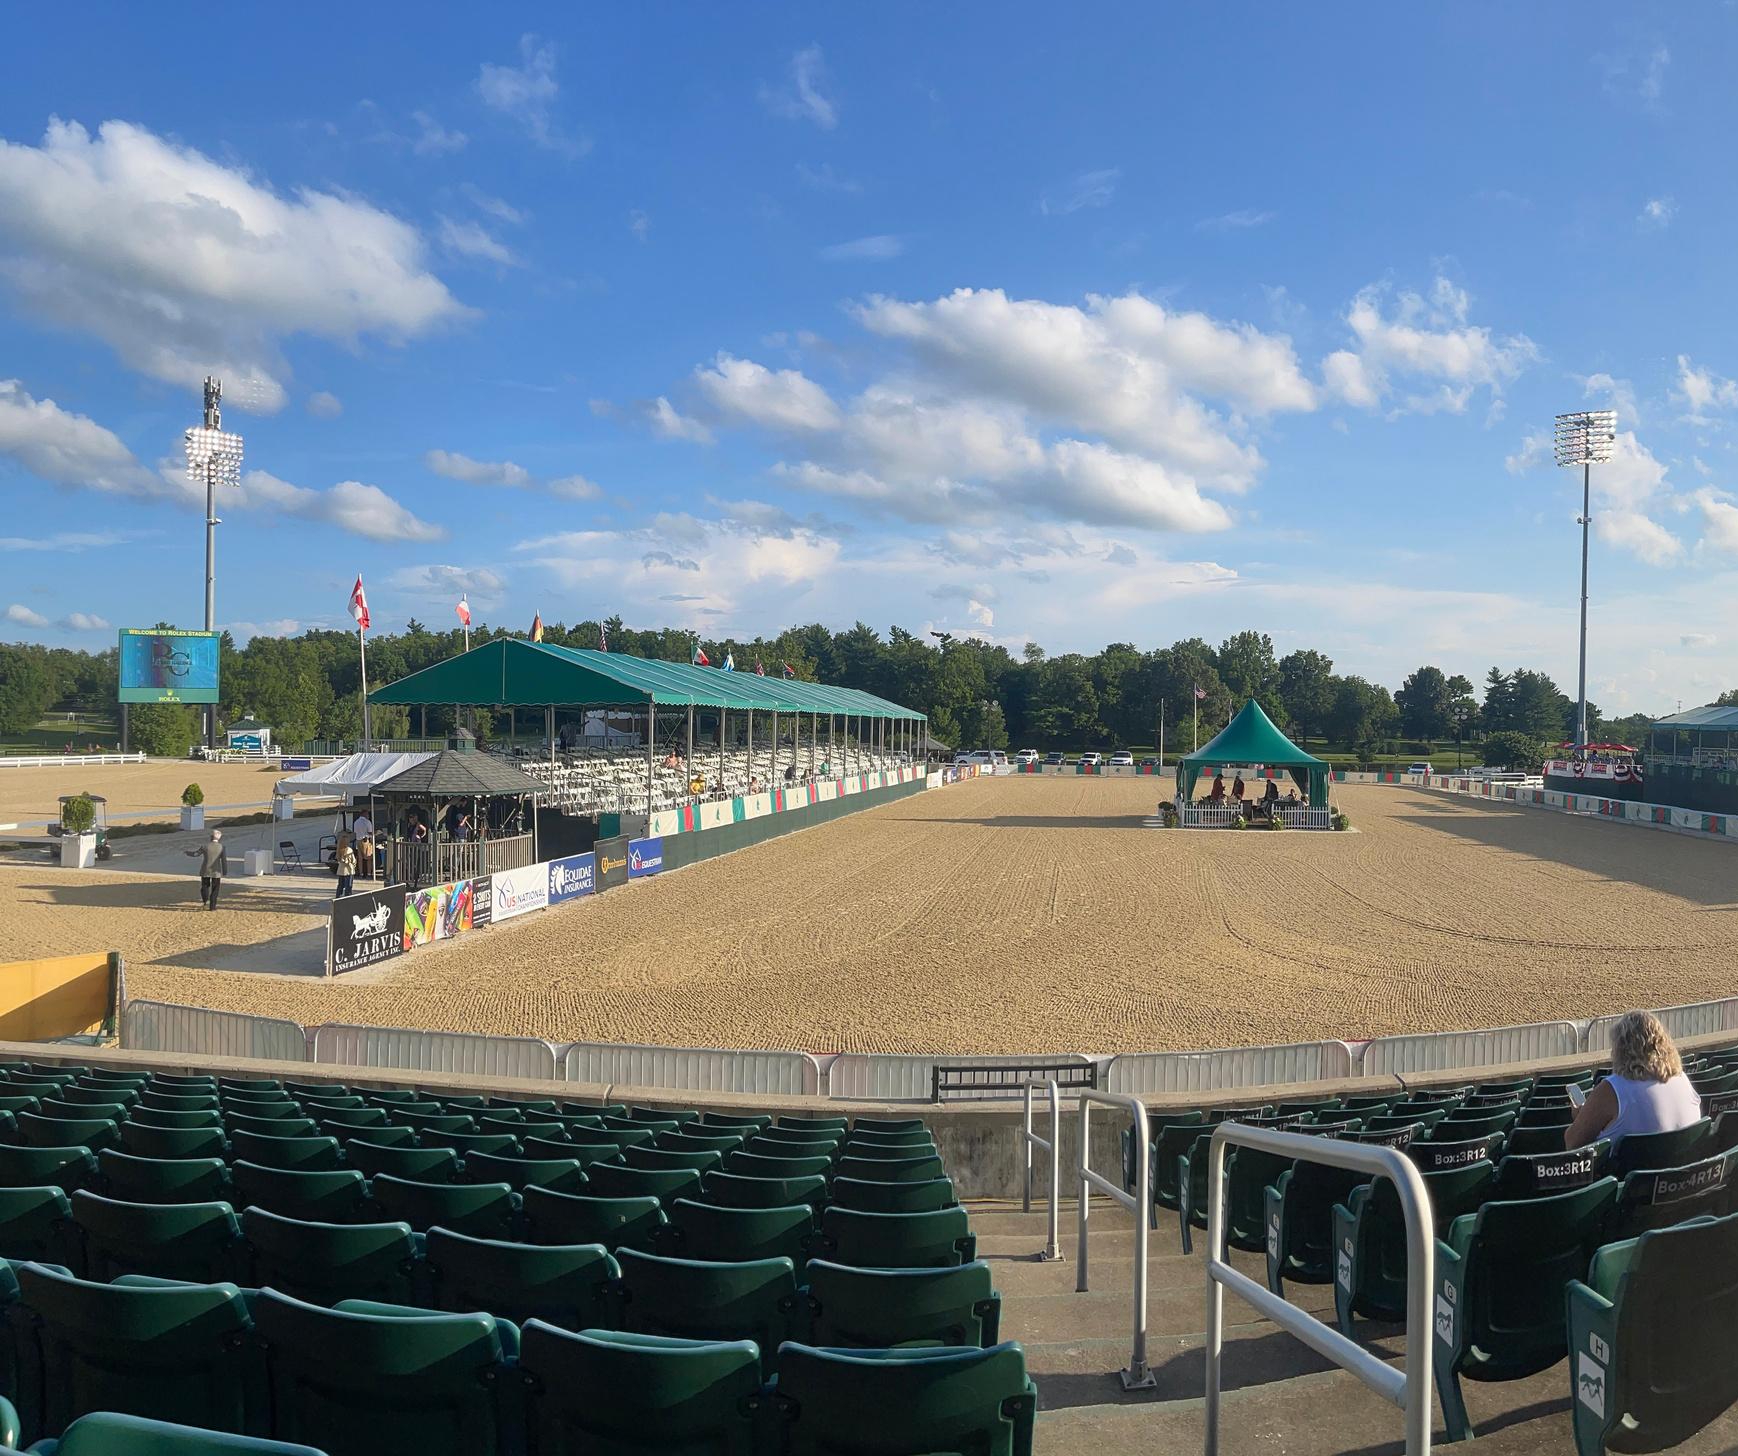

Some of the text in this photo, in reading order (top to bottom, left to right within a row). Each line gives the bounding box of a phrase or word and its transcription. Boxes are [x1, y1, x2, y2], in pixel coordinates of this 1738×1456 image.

[641, 856, 663, 870] EQUESTRIAN
[564, 865, 592, 883] EQUIDAE
[506, 887, 546, 908] US NATIONAL
[335, 931, 401, 964] C. JARVIS
[335, 955, 368, 972] INSURANCE
[368, 949, 390, 962] AGENCY
[1435, 1147, 1486, 1165] Box:3R12
[1537, 1159, 1591, 1178] Box:3R12
[1657, 1163, 1721, 1194] Box:4R13
[1594, 1342, 1604, 1358] H
